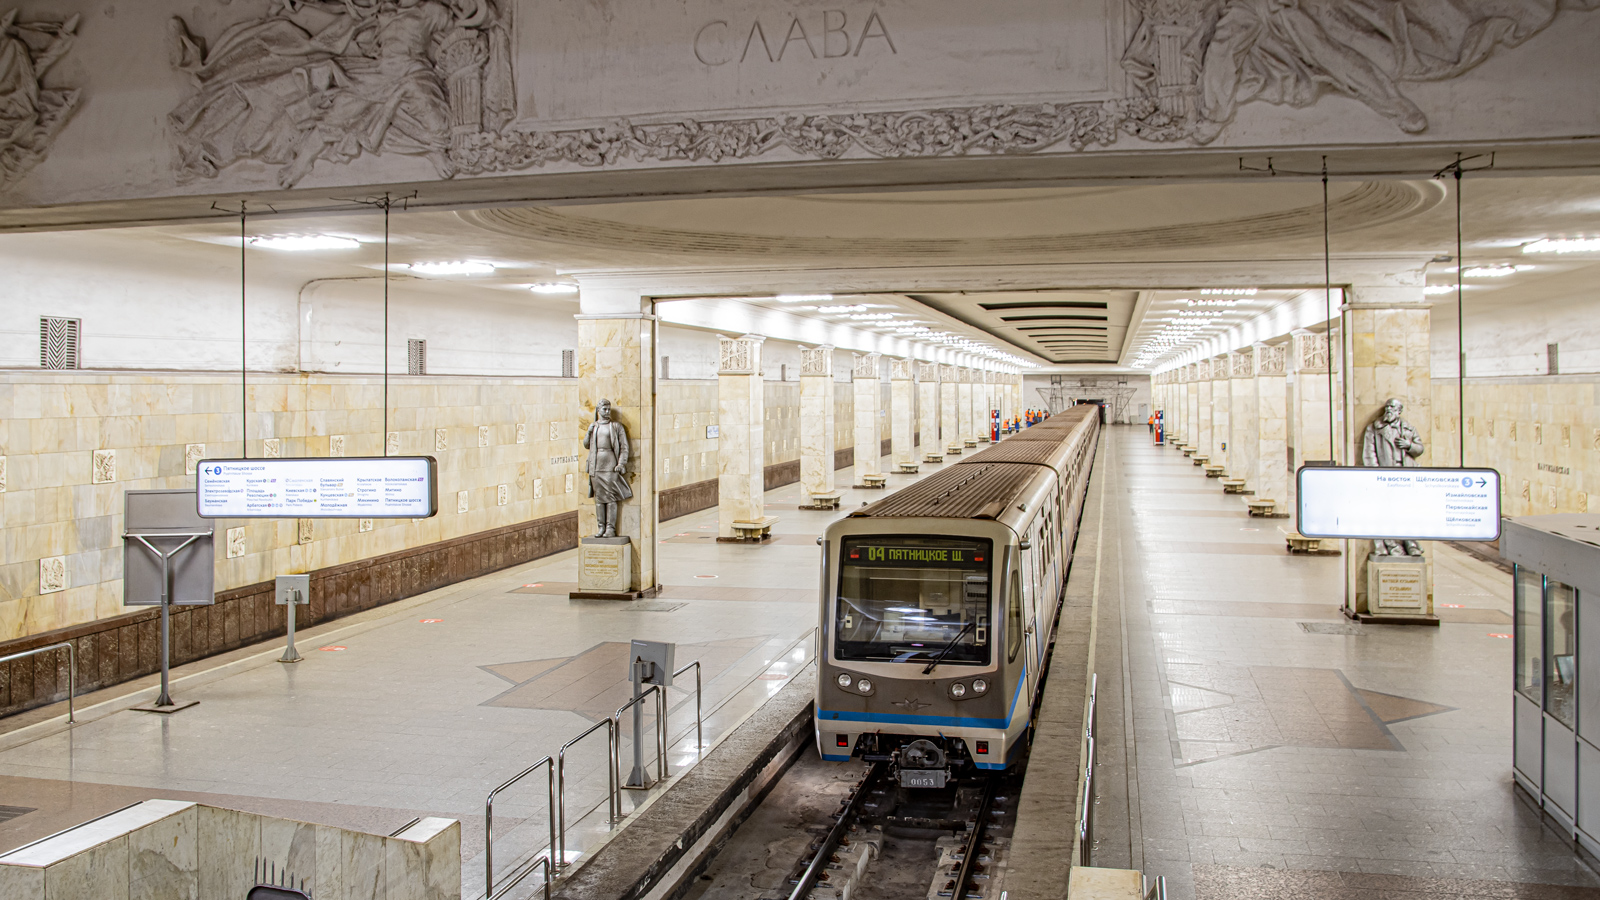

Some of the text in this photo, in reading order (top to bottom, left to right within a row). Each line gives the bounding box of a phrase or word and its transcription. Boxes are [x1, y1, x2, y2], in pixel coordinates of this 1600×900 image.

[693, 9, 897, 66] СЛАВА
[868, 547, 964, 562] 04 ПЯТНИЦКОЕ Ш.
